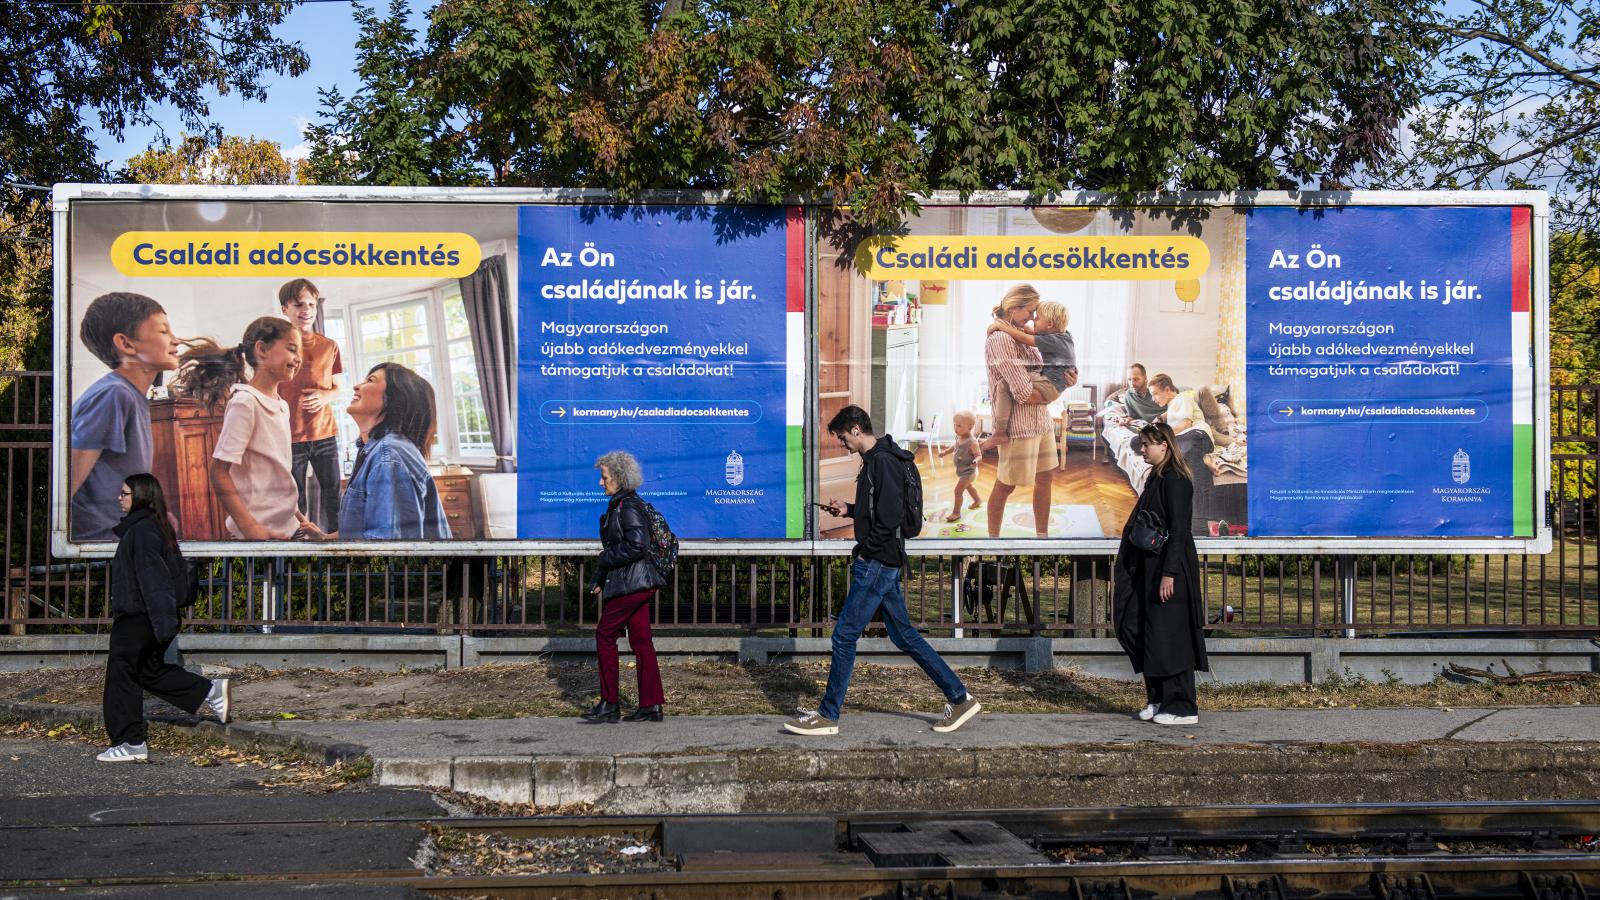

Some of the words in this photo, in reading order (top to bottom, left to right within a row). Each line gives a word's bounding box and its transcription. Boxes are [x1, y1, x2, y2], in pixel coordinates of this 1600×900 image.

[133, 242, 240, 266] Családi
[248, 242, 460, 266] adócsökkentés
[540, 247, 573, 267] Az
[579, 241, 615, 267] Ön
[876, 246, 977, 269] Családi
[986, 246, 1190, 269] adócsökkentés
[1268, 249, 1300, 269] Az
[1305, 243, 1341, 269] Ön
[541, 278, 689, 305] családjának
[694, 279, 713, 300] is
[717, 279, 757, 305] jár.
[1268, 280, 1414, 306] családjának
[1420, 279, 1439, 300] is
[1442, 279, 1482, 305] jár.
[541, 320, 669, 337] Magyarországon
[1269, 321, 1394, 338] Magyarországon
[541, 341, 585, 358] újabb
[588, 341, 748, 358] adókedvezményekkel
[1269, 342, 1312, 359] újabb
[1315, 342, 1474, 358] adókedvezményekkel
[540, 363, 629, 379] támogatjuk
[632, 366, 643, 376] a
[646, 363, 734, 376] családokat!
[1268, 362, 1356, 379] támogatjuk
[1358, 366, 1370, 376] a
[1373, 362, 1460, 376] családokat!
[572, 406, 749, 419] kormany.hu/csaladiadocsokkentes
[1300, 405, 1476, 418] kormany.hu/csaladiadocsokkentes
[705, 487, 764, 496] MAGYARORSZÁG
[714, 496, 756, 504] KORMÁNYA
